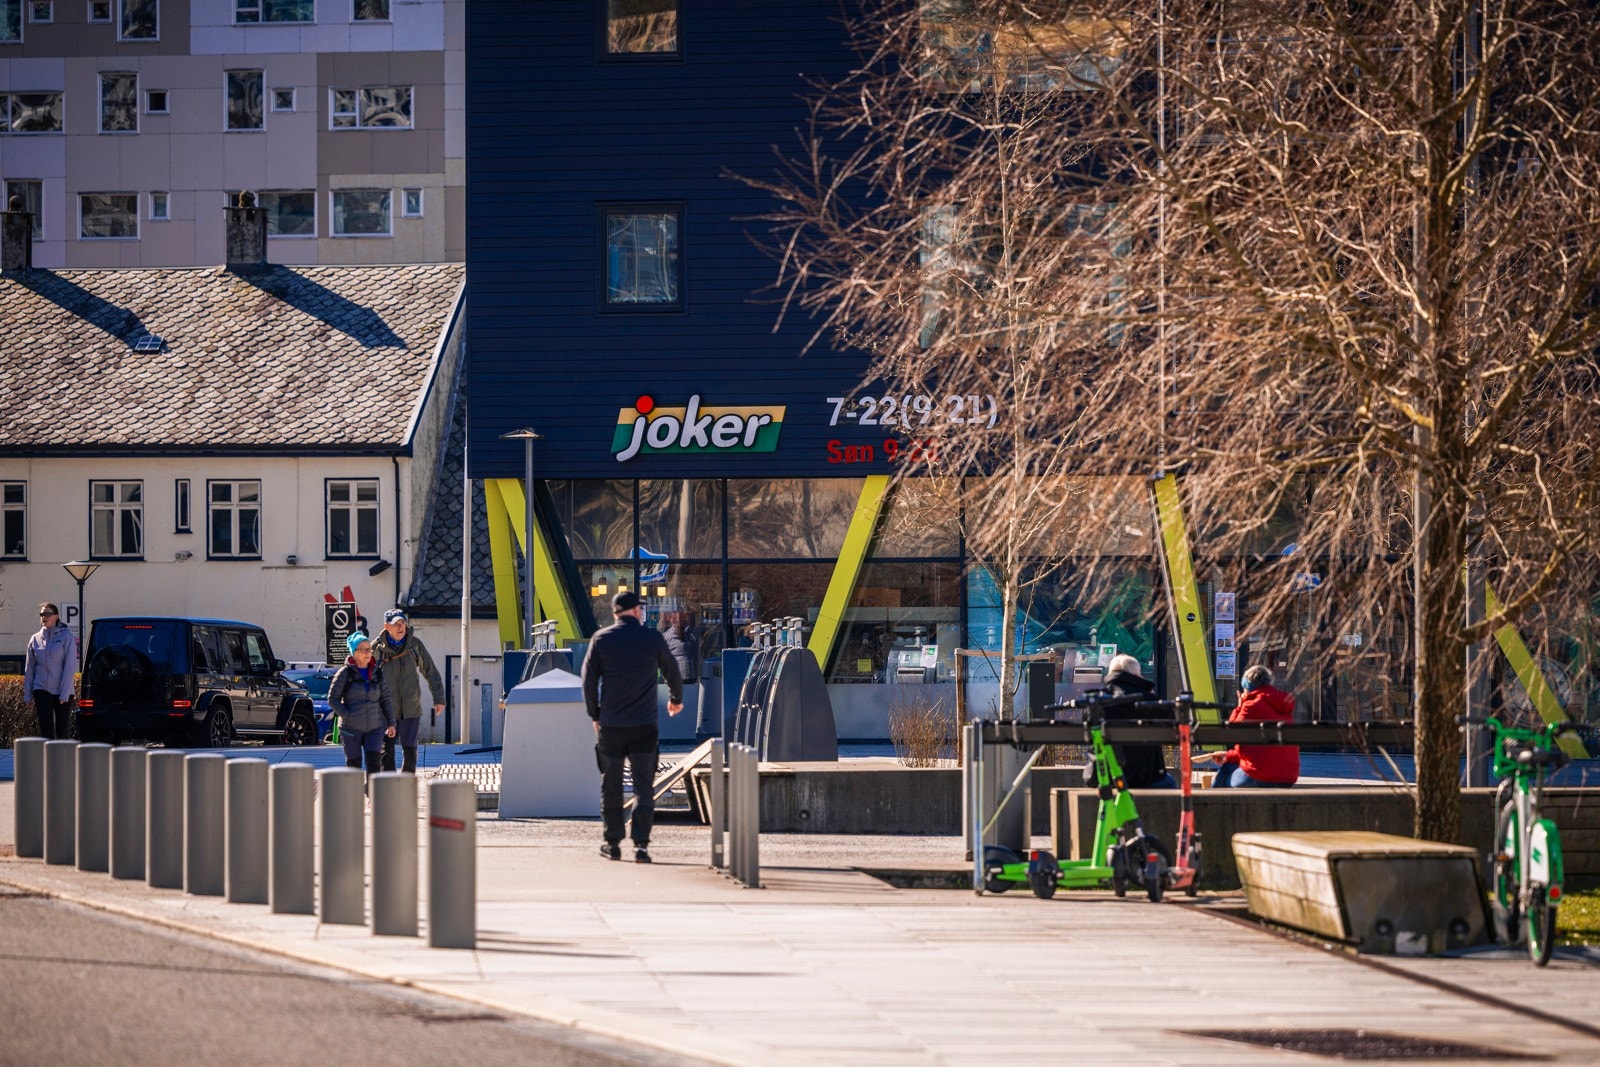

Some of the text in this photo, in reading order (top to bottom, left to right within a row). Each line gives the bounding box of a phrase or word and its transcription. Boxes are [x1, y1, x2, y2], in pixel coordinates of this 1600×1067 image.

[616, 394, 771, 462] joker
[826, 439, 874, 463] Søn
[67, 606, 78, 623] P
